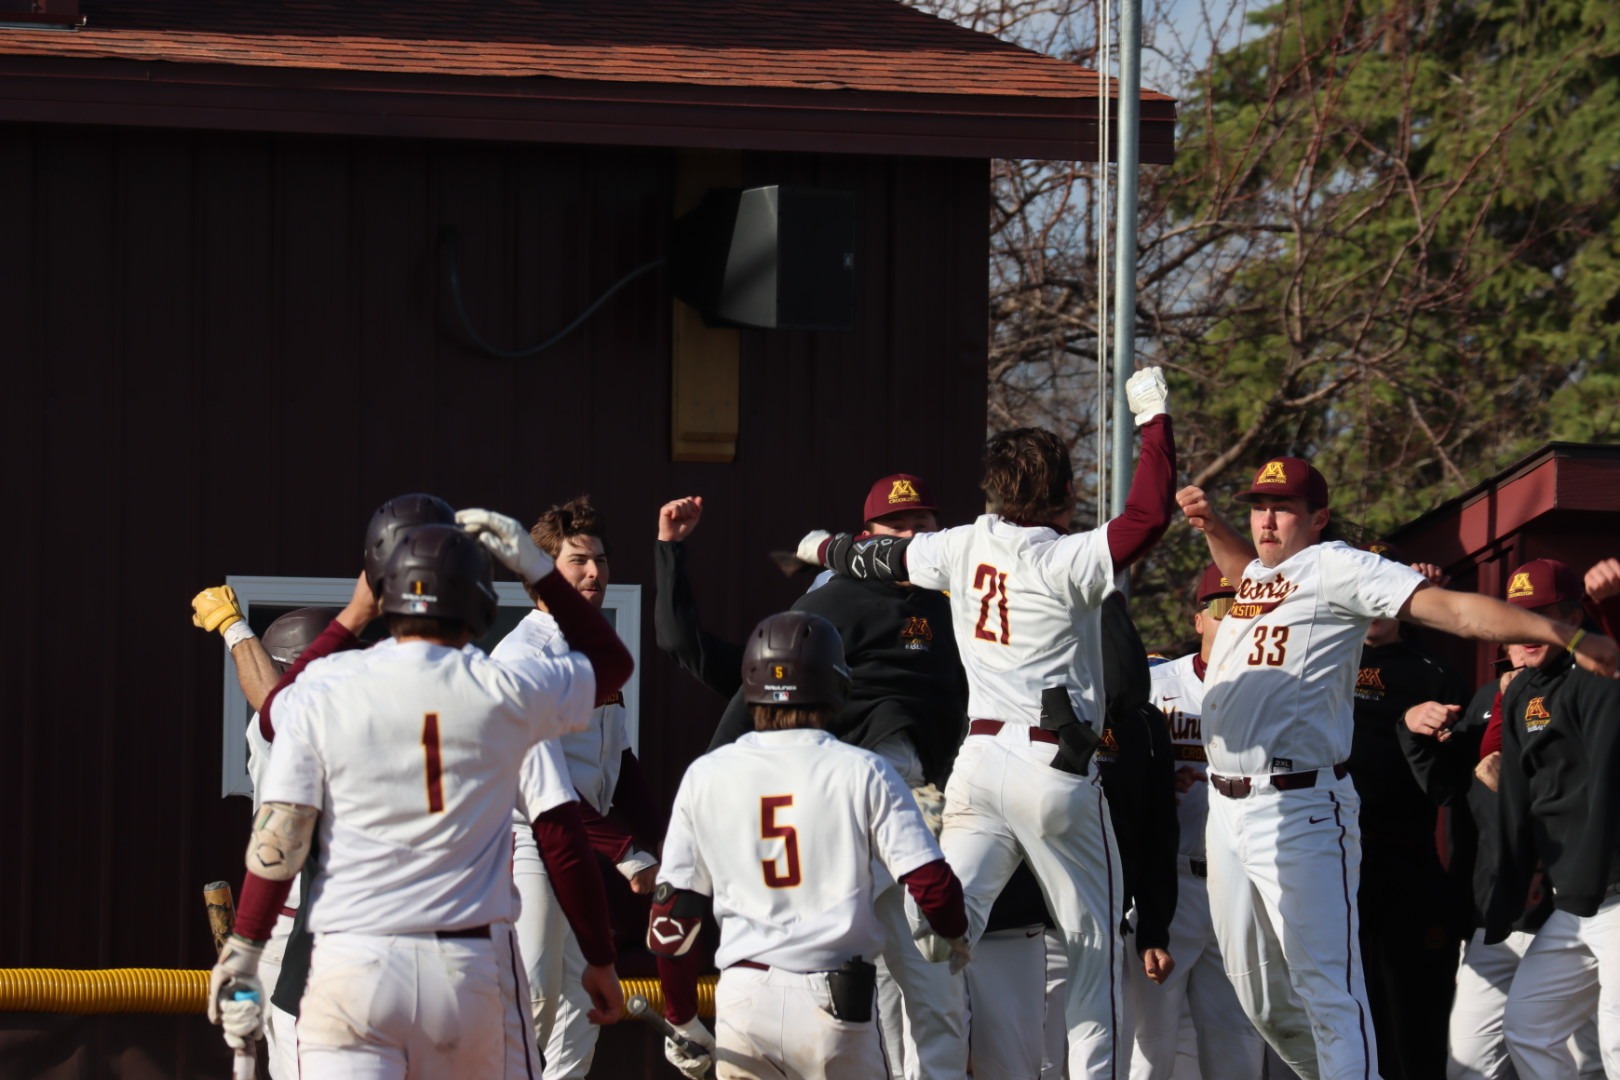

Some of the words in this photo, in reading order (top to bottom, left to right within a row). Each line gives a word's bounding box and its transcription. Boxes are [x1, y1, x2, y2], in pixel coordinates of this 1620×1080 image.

[973, 563, 1011, 645] 21
[1231, 604, 1263, 617] KSTON
[774, 665, 784, 679] 5
[1247, 625, 1290, 667] 33
[420, 712, 446, 815] 1
[760, 794, 801, 888] 5
